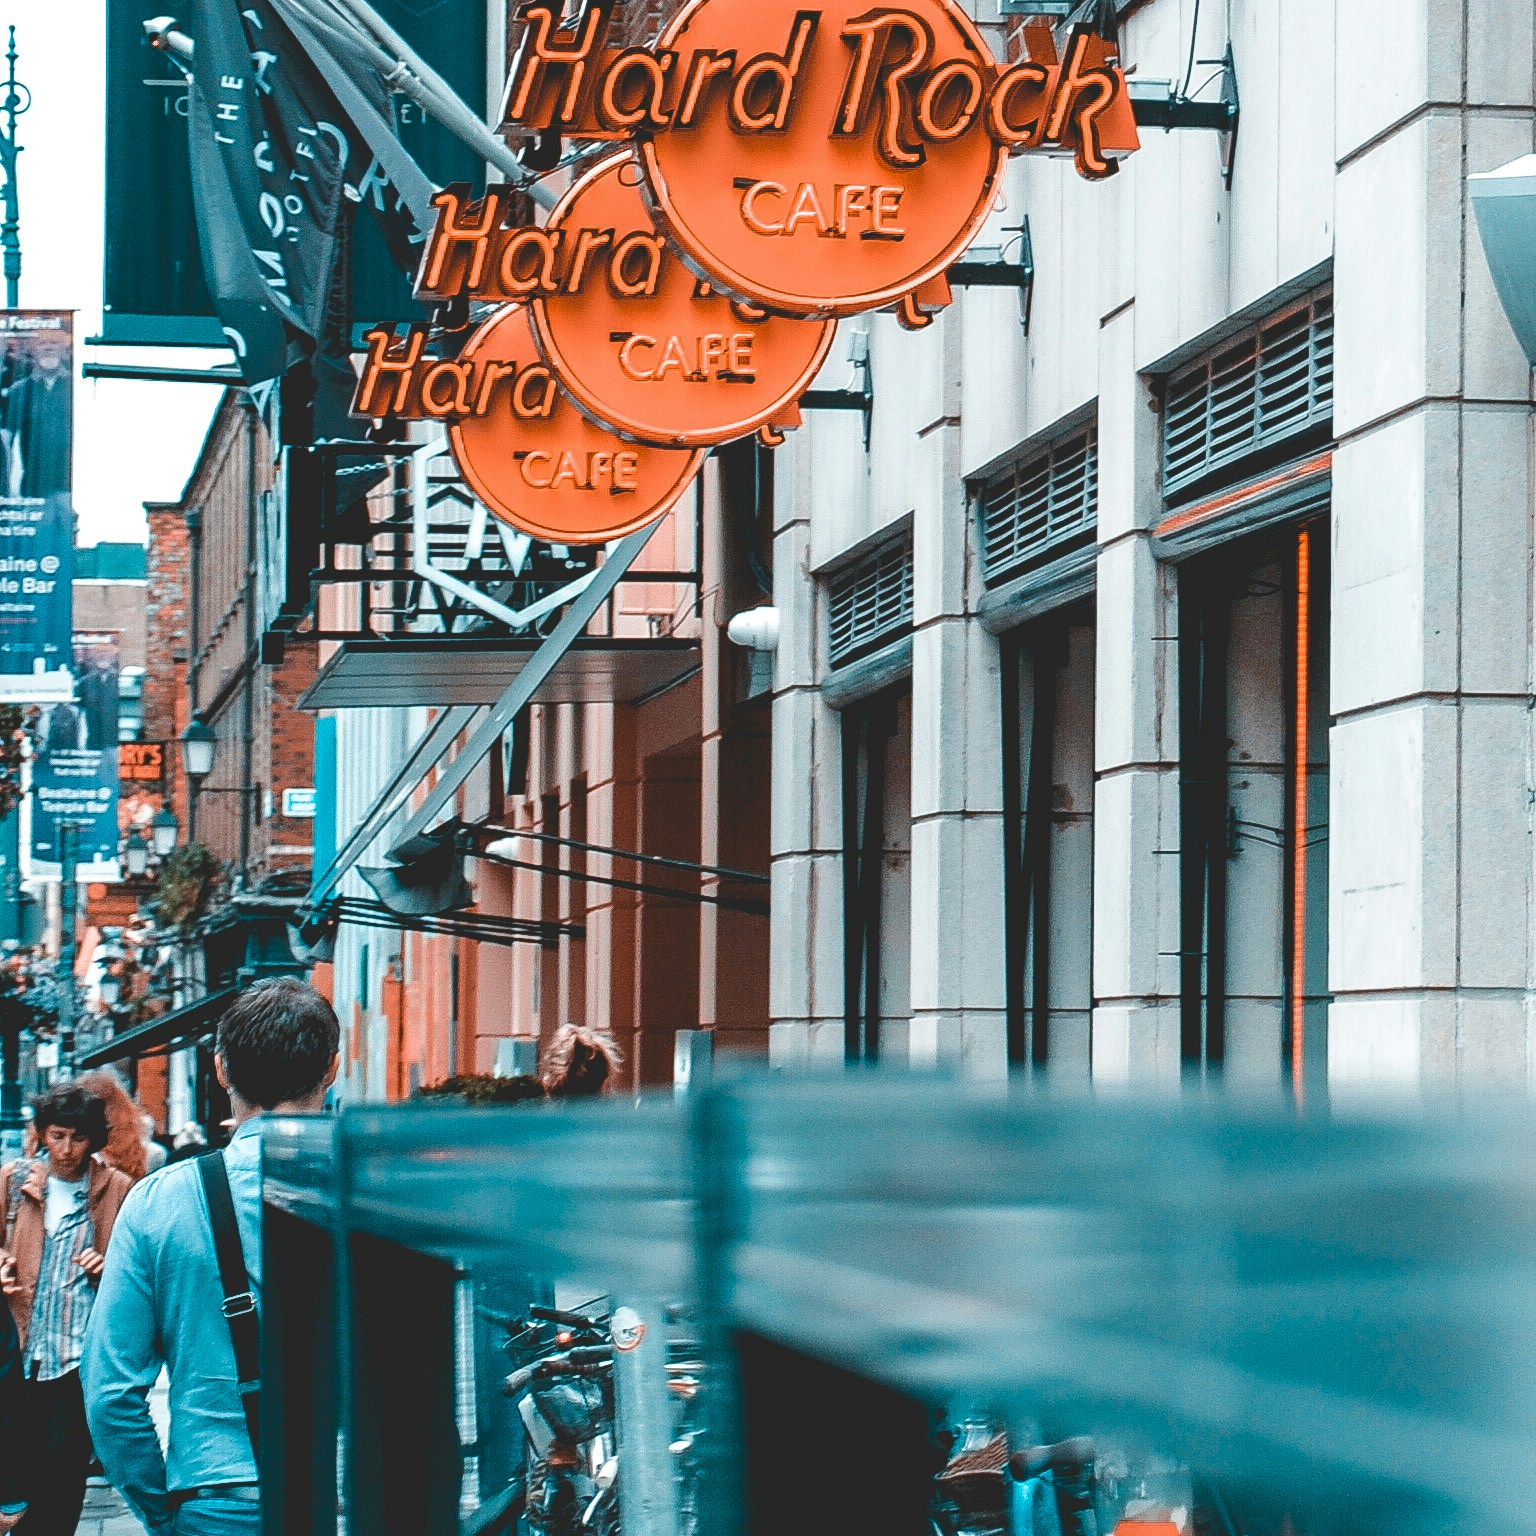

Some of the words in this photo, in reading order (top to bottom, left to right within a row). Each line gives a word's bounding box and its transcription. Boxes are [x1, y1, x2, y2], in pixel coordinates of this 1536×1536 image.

[829, 7, 1134, 180] Rock
[732, 177, 906, 241] CAFE
[609, 332, 757, 385] CAFE
[513, 450, 640, 495] CAFE
